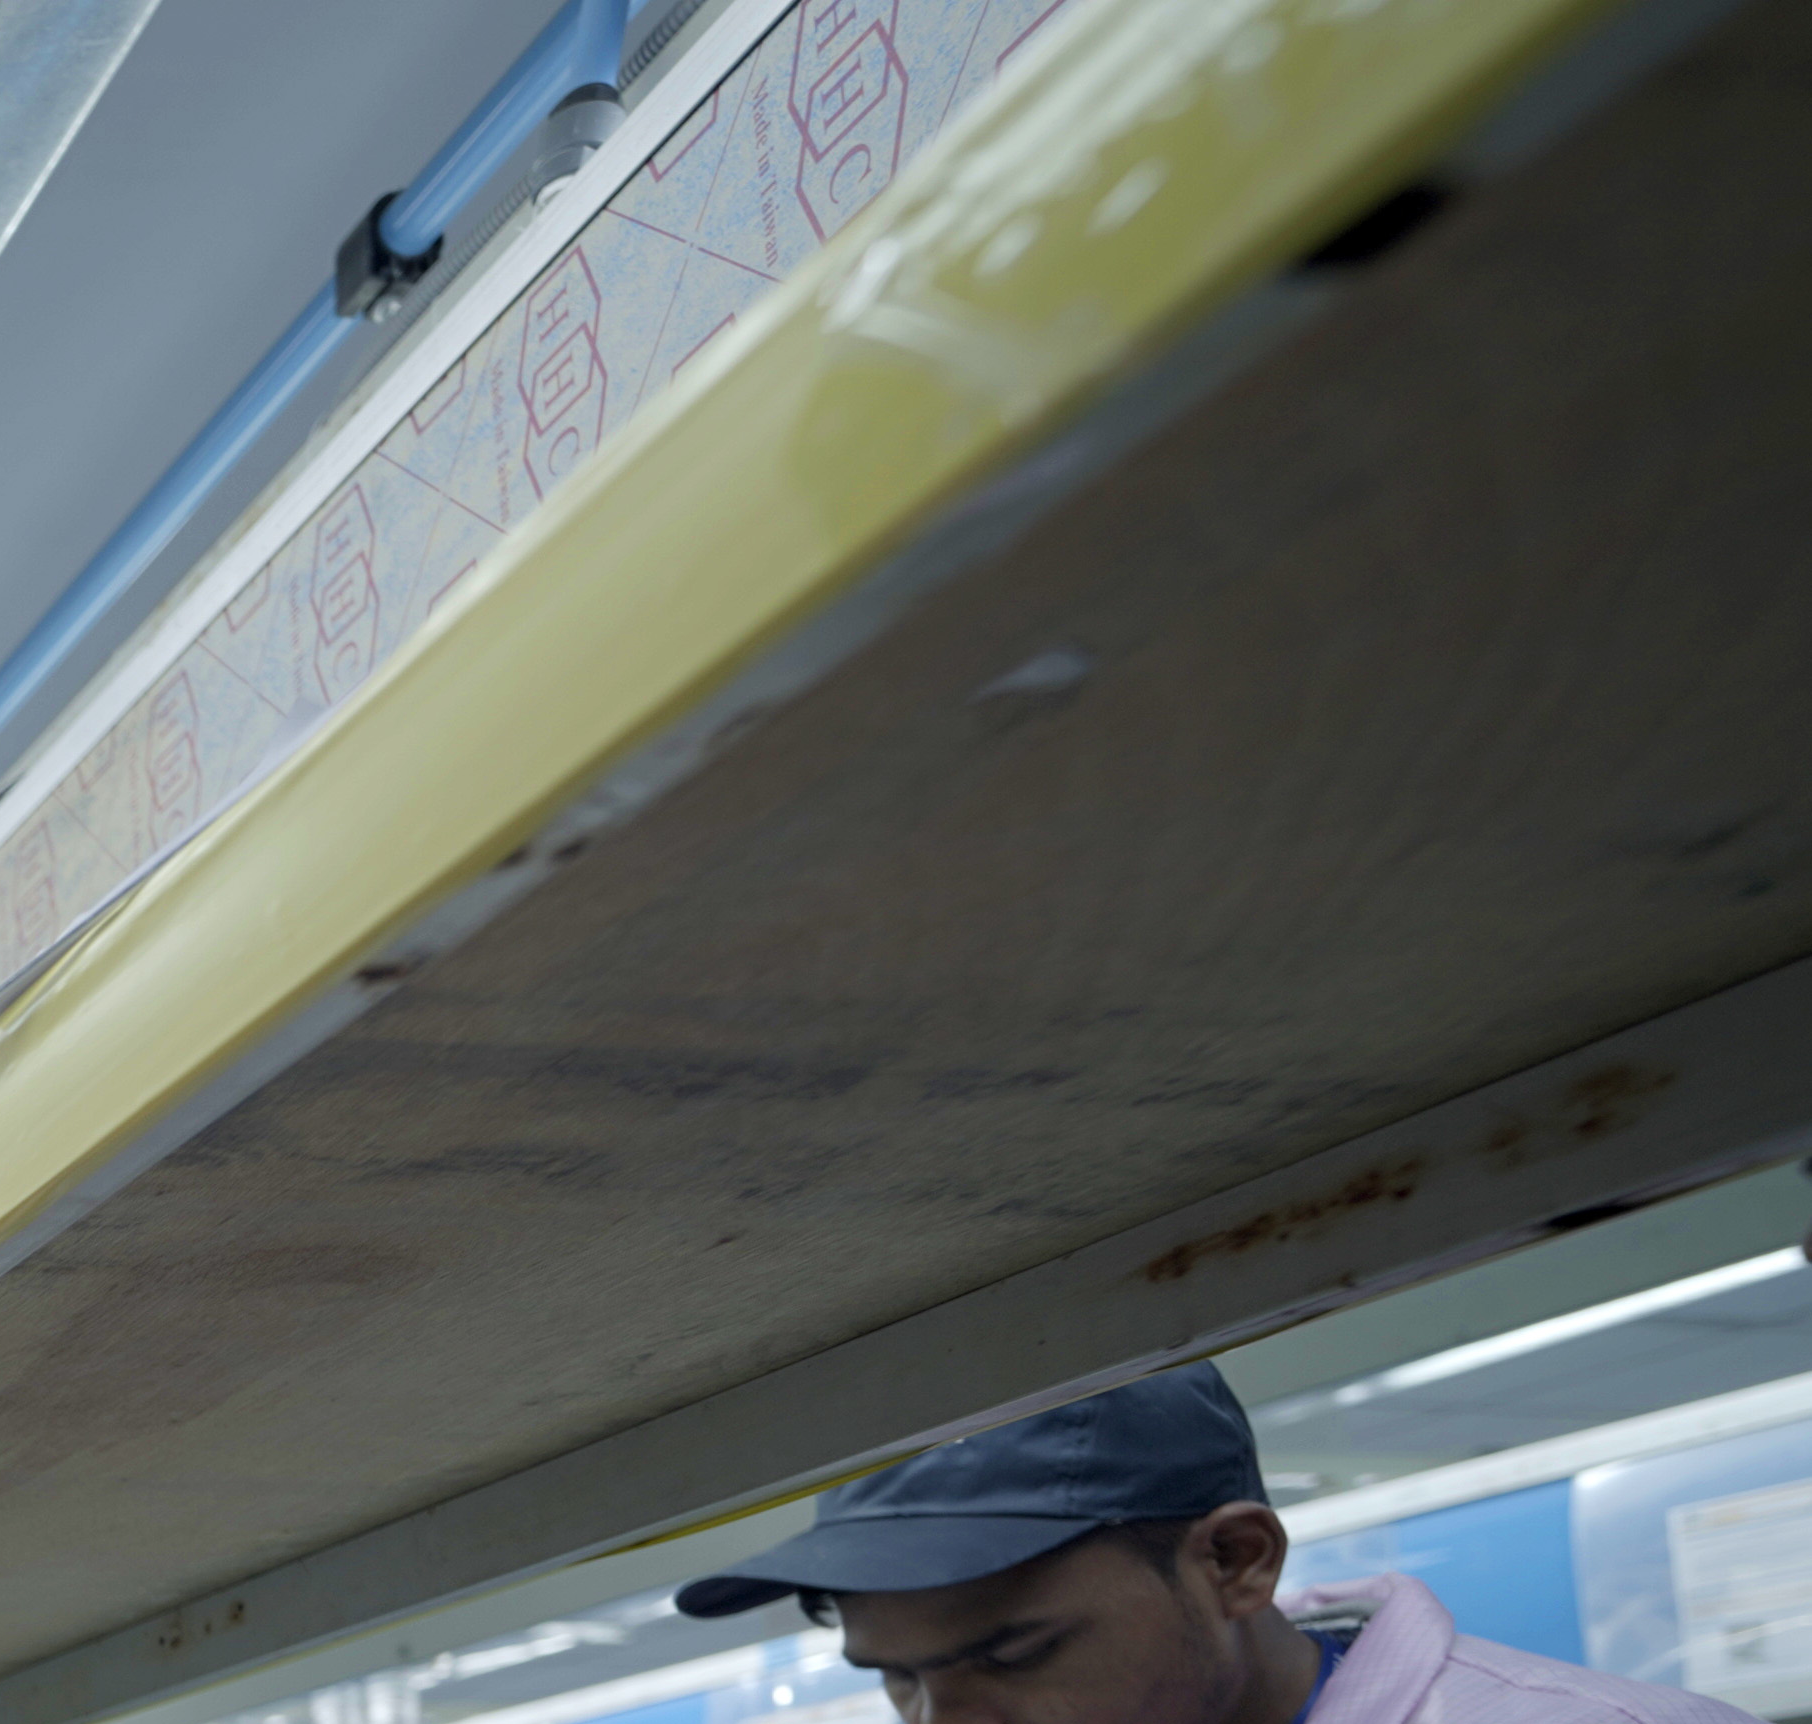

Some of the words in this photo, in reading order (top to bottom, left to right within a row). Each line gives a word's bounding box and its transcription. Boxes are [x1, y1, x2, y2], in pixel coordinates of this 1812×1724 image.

[753, 75, 771, 149] Made
[757, 146, 775, 177] in
[760, 174, 779, 267] Taiwan
[537, 281, 581, 477] HHC
